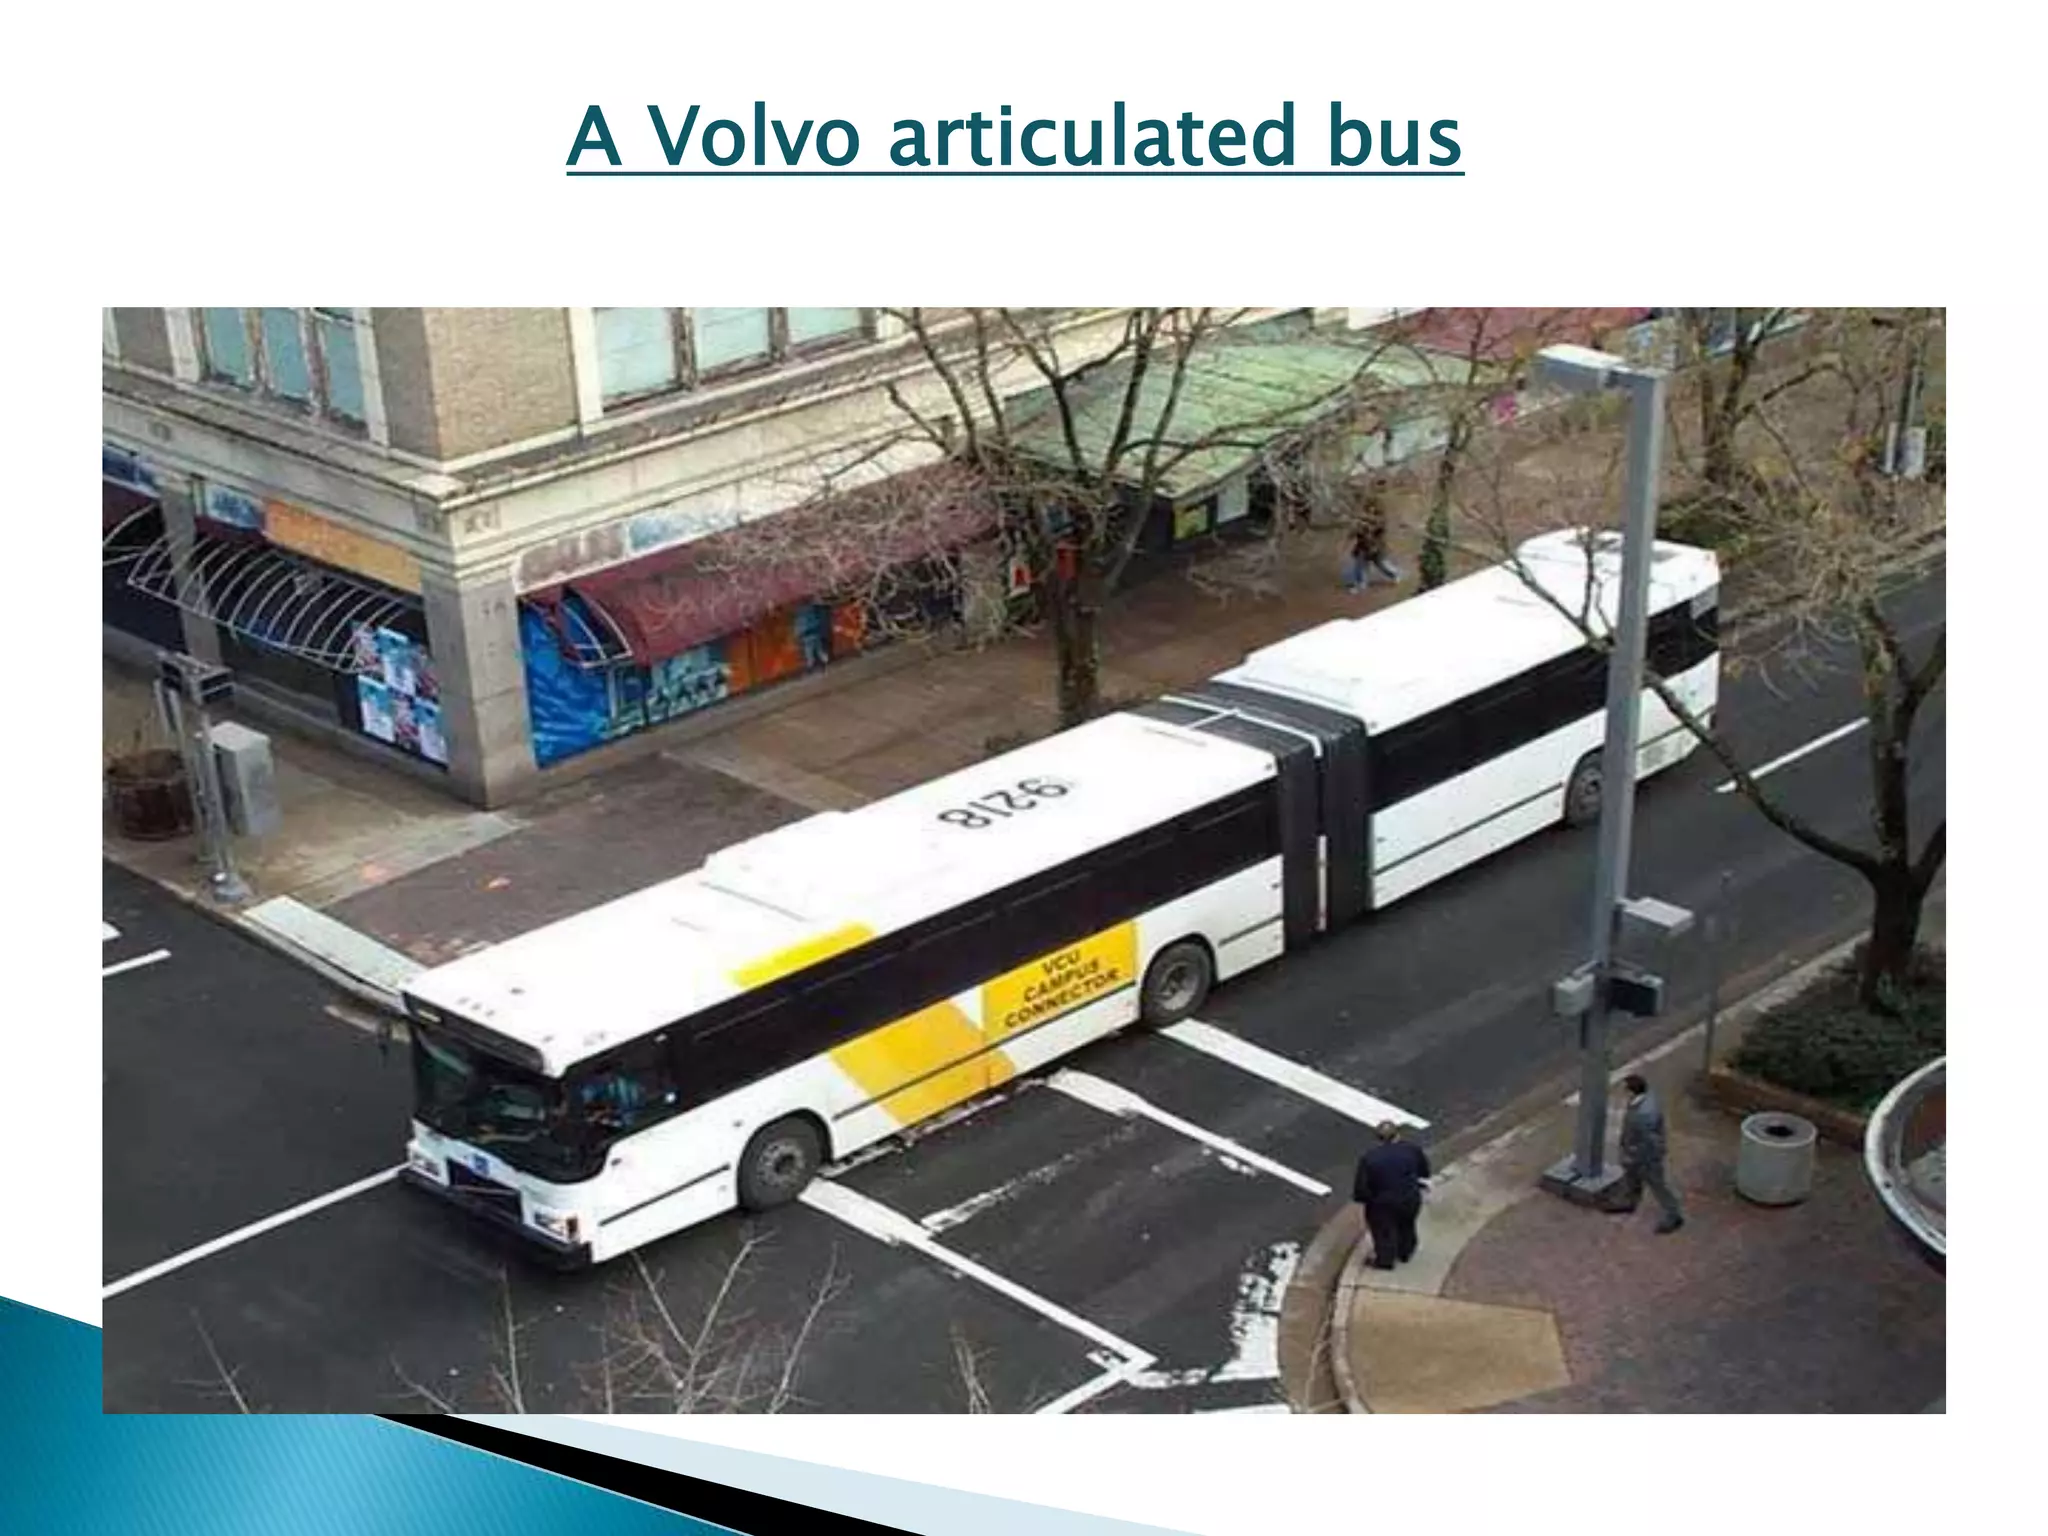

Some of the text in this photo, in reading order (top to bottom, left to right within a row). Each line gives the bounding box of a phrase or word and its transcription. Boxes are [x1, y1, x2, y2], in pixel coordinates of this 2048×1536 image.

[938, 778, 1068, 829] 9218
[1023, 957, 1100, 1003] CAMPUS
[1041, 949, 1081, 975] VCU
[1004, 967, 1120, 1029] CONNECTOR
